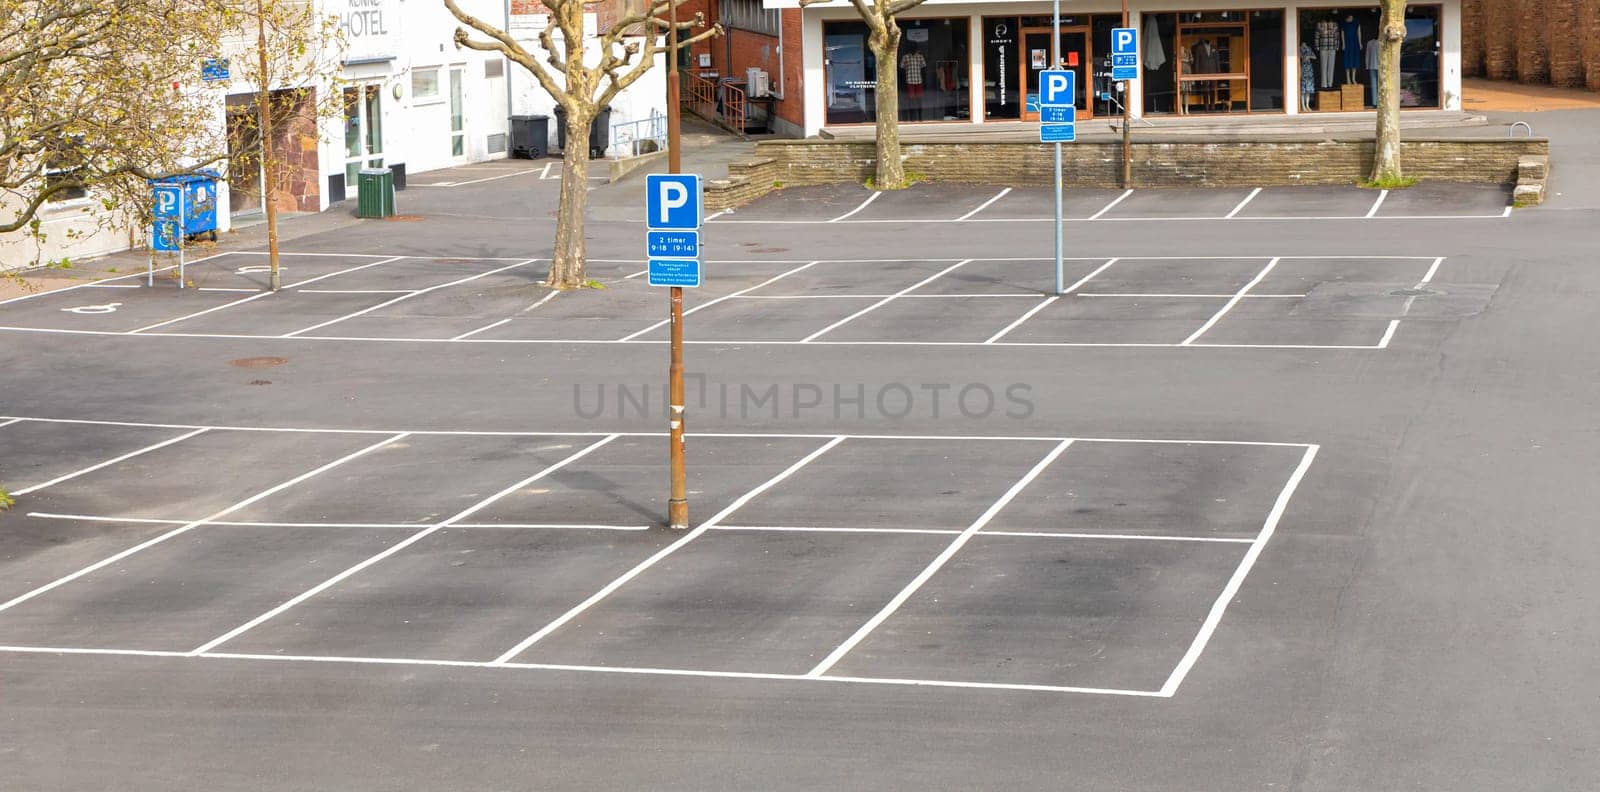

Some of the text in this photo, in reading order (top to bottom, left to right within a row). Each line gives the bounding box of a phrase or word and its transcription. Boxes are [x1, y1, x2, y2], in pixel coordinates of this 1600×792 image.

[340, 10, 388, 39] HOTEL
[1118, 31, 1132, 51] P
[1048, 75, 1068, 102] P
[659, 181, 688, 223] P
